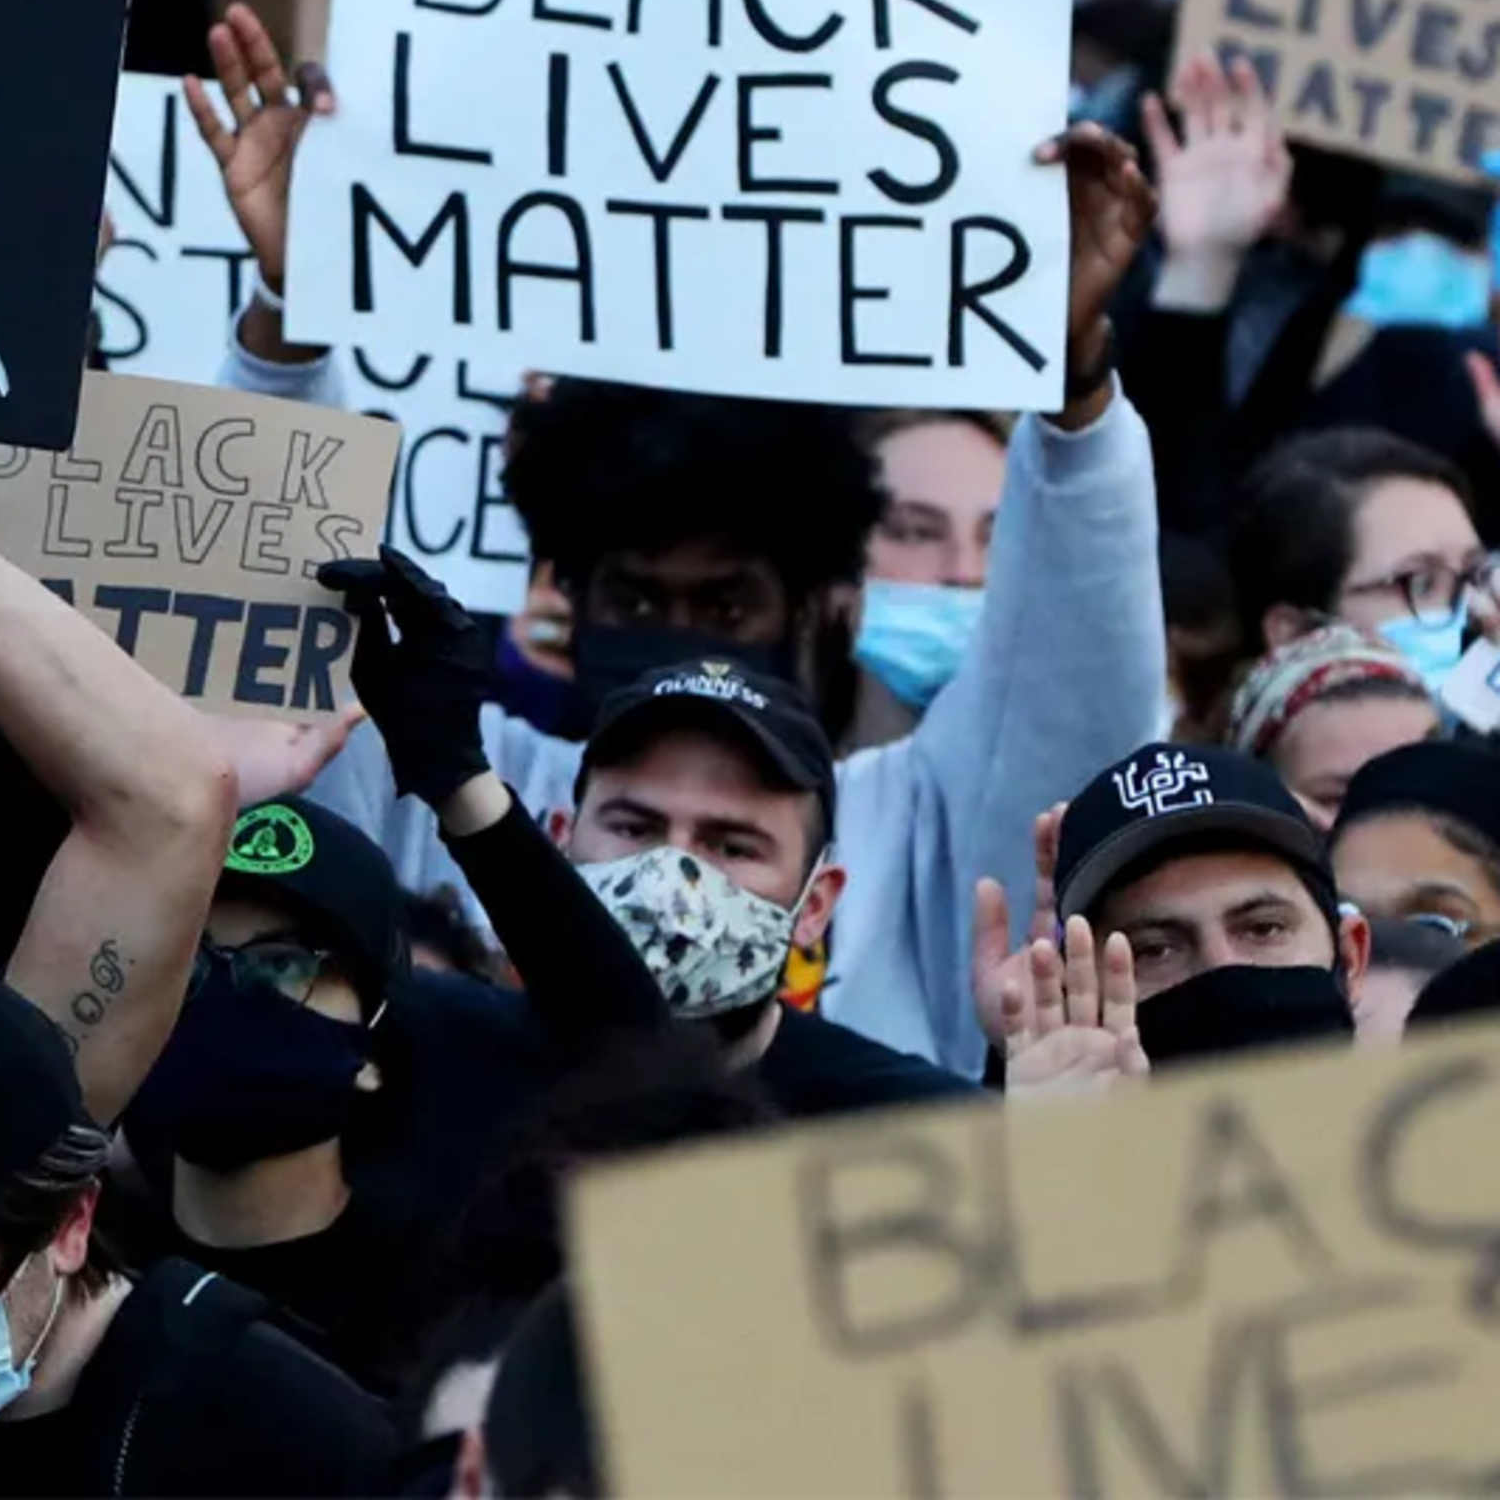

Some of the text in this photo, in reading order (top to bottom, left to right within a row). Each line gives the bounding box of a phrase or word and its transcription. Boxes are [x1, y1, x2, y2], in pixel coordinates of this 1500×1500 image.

[393, 31, 961, 205] LIVES
[351, 182, 1048, 373] MATTER
[41, 483, 366, 581] LIVES
